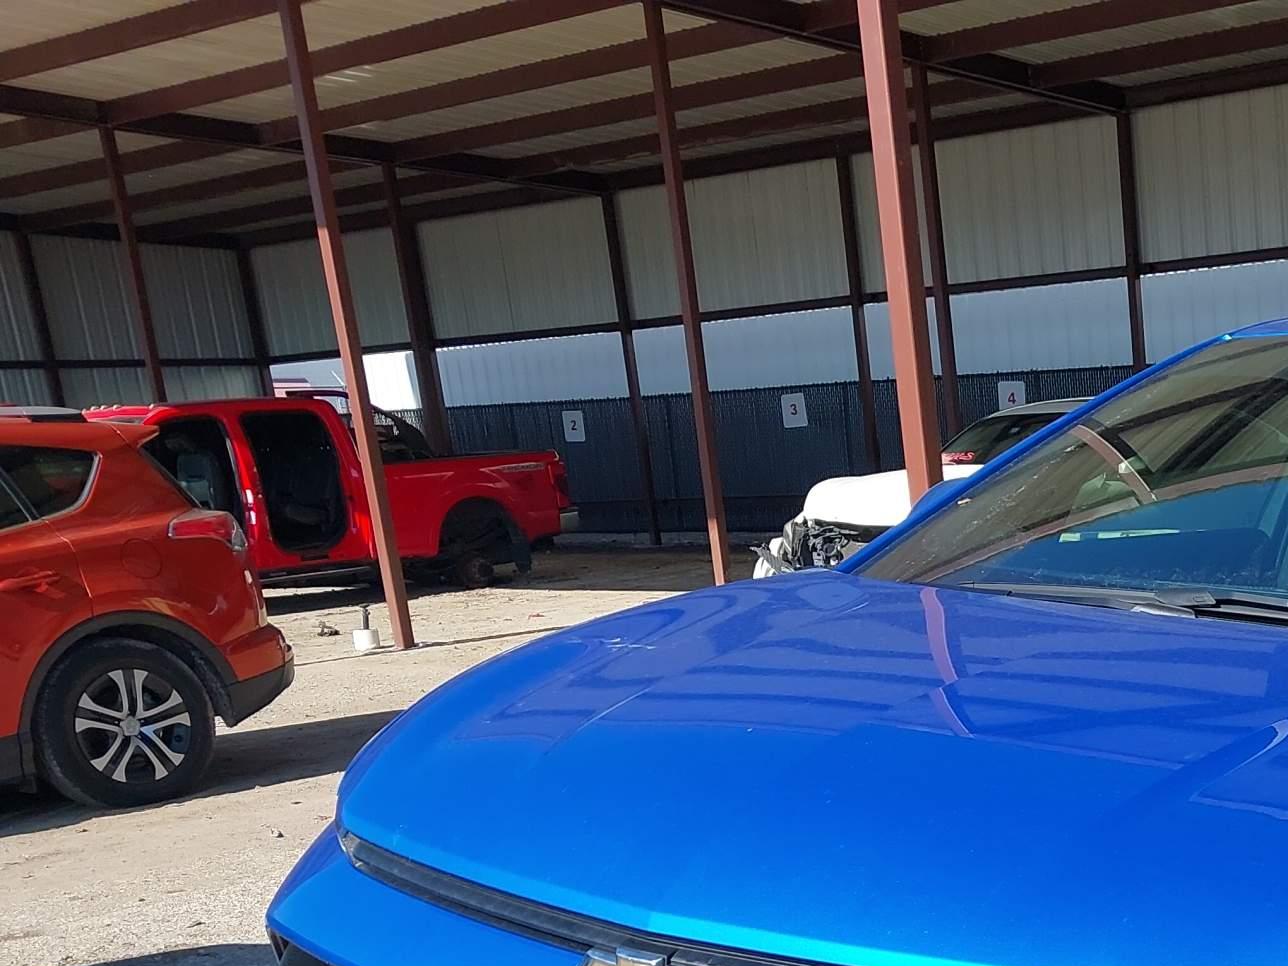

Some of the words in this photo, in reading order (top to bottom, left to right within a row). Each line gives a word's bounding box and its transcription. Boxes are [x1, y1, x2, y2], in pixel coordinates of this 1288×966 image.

[1007, 391, 1017, 405] 4
[790, 403, 798, 416] 3
[570, 419, 577, 431] 2
